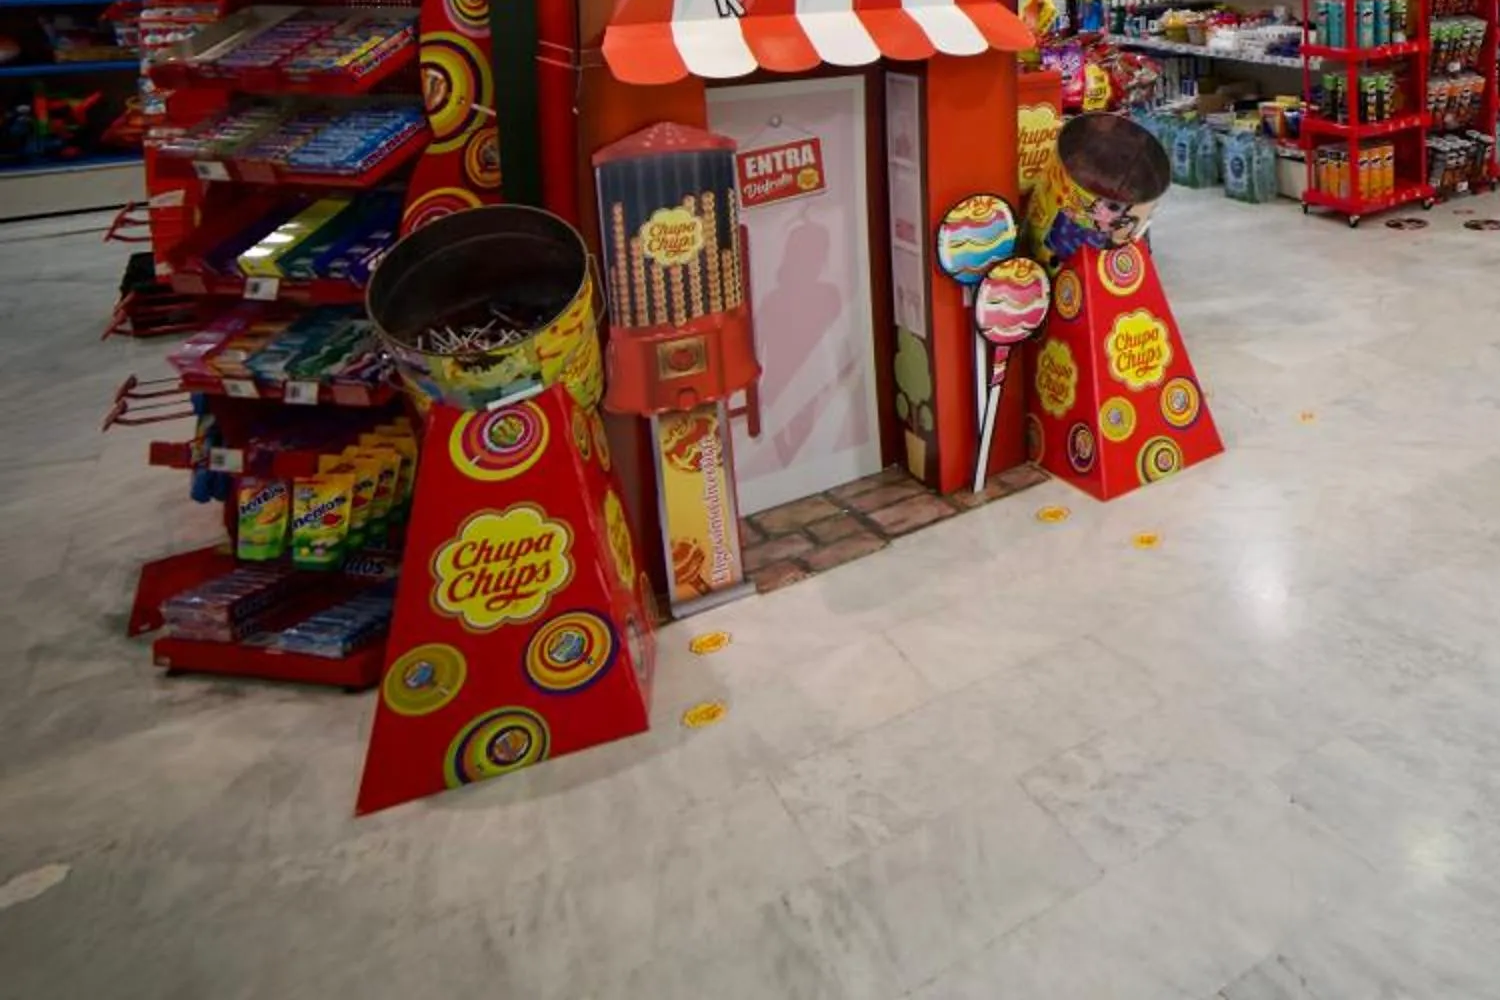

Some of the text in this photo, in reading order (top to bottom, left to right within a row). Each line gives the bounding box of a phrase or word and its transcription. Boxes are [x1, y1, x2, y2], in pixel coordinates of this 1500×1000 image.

[1019, 127, 1057, 147] hupa
[745, 143, 816, 179] ENTRA
[650, 221, 697, 238] Chupa
[646, 234, 695, 257] Chups
[1114, 327, 1160, 351] Chupa
[1116, 346, 1164, 377] Chups
[452, 531, 555, 570] Chupa
[447, 559, 552, 612] Chups
